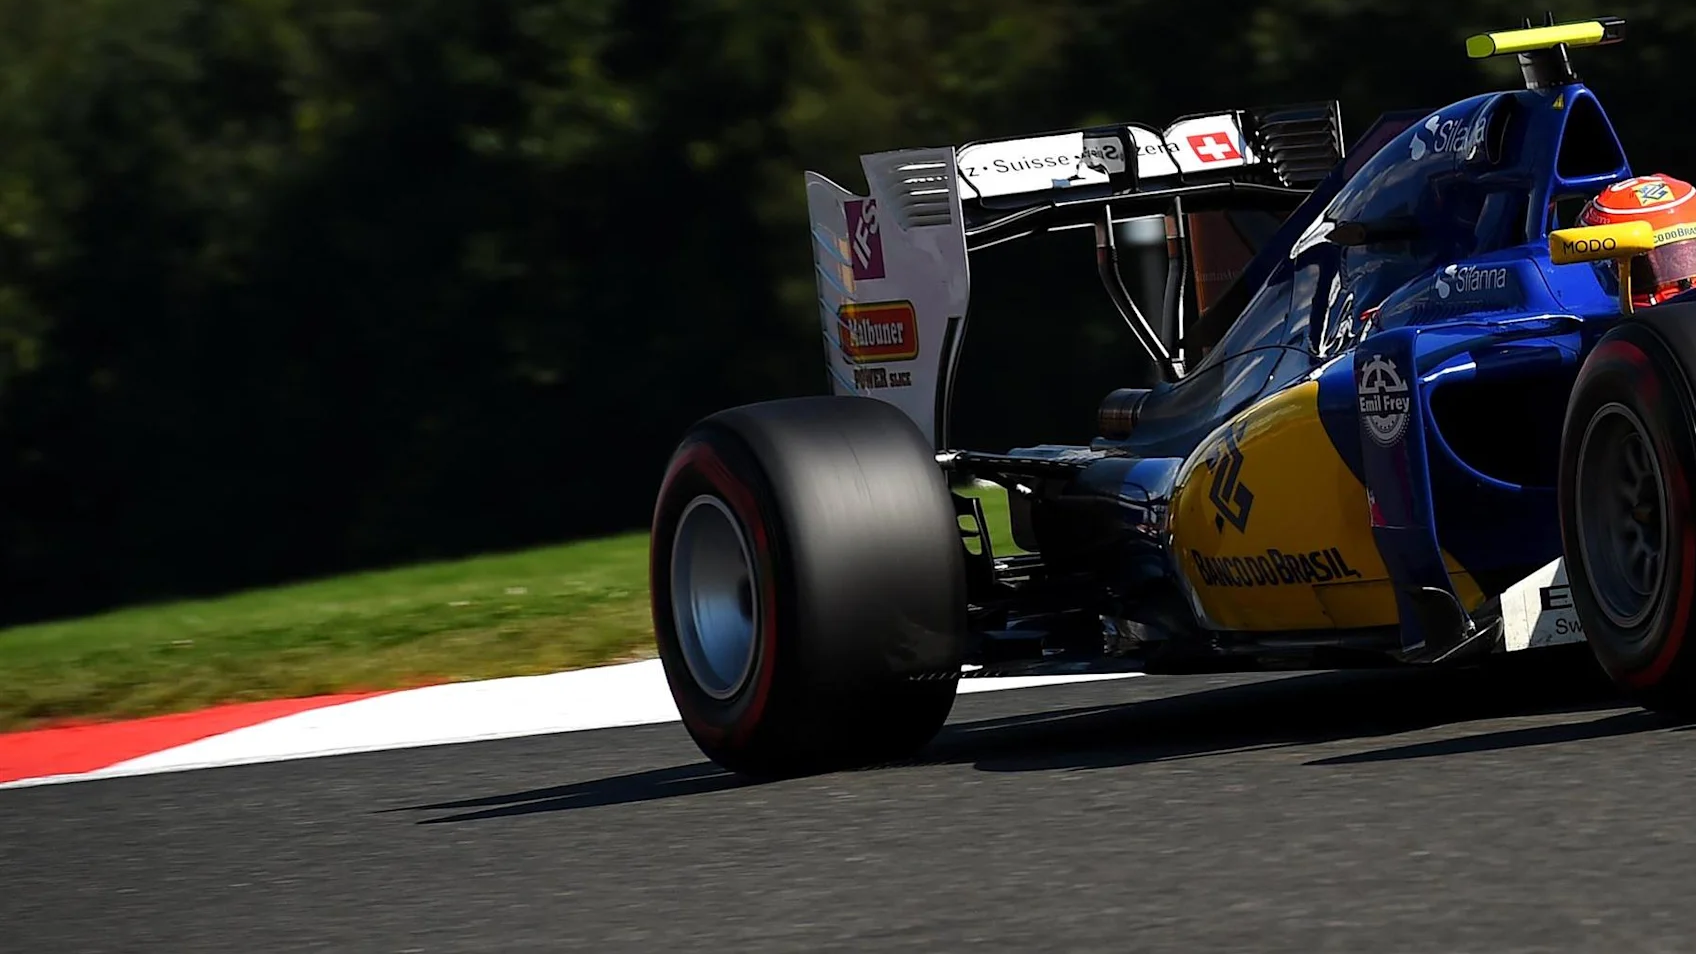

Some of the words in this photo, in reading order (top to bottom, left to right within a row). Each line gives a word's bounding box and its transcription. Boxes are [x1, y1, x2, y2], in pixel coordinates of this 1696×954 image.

[1434, 117, 1486, 152] Silaa
[1563, 237, 1616, 256] MODO
[1456, 265, 1507, 293] Silanna
[1359, 394, 1382, 413] Emil
[1383, 395, 1410, 413] Frey
